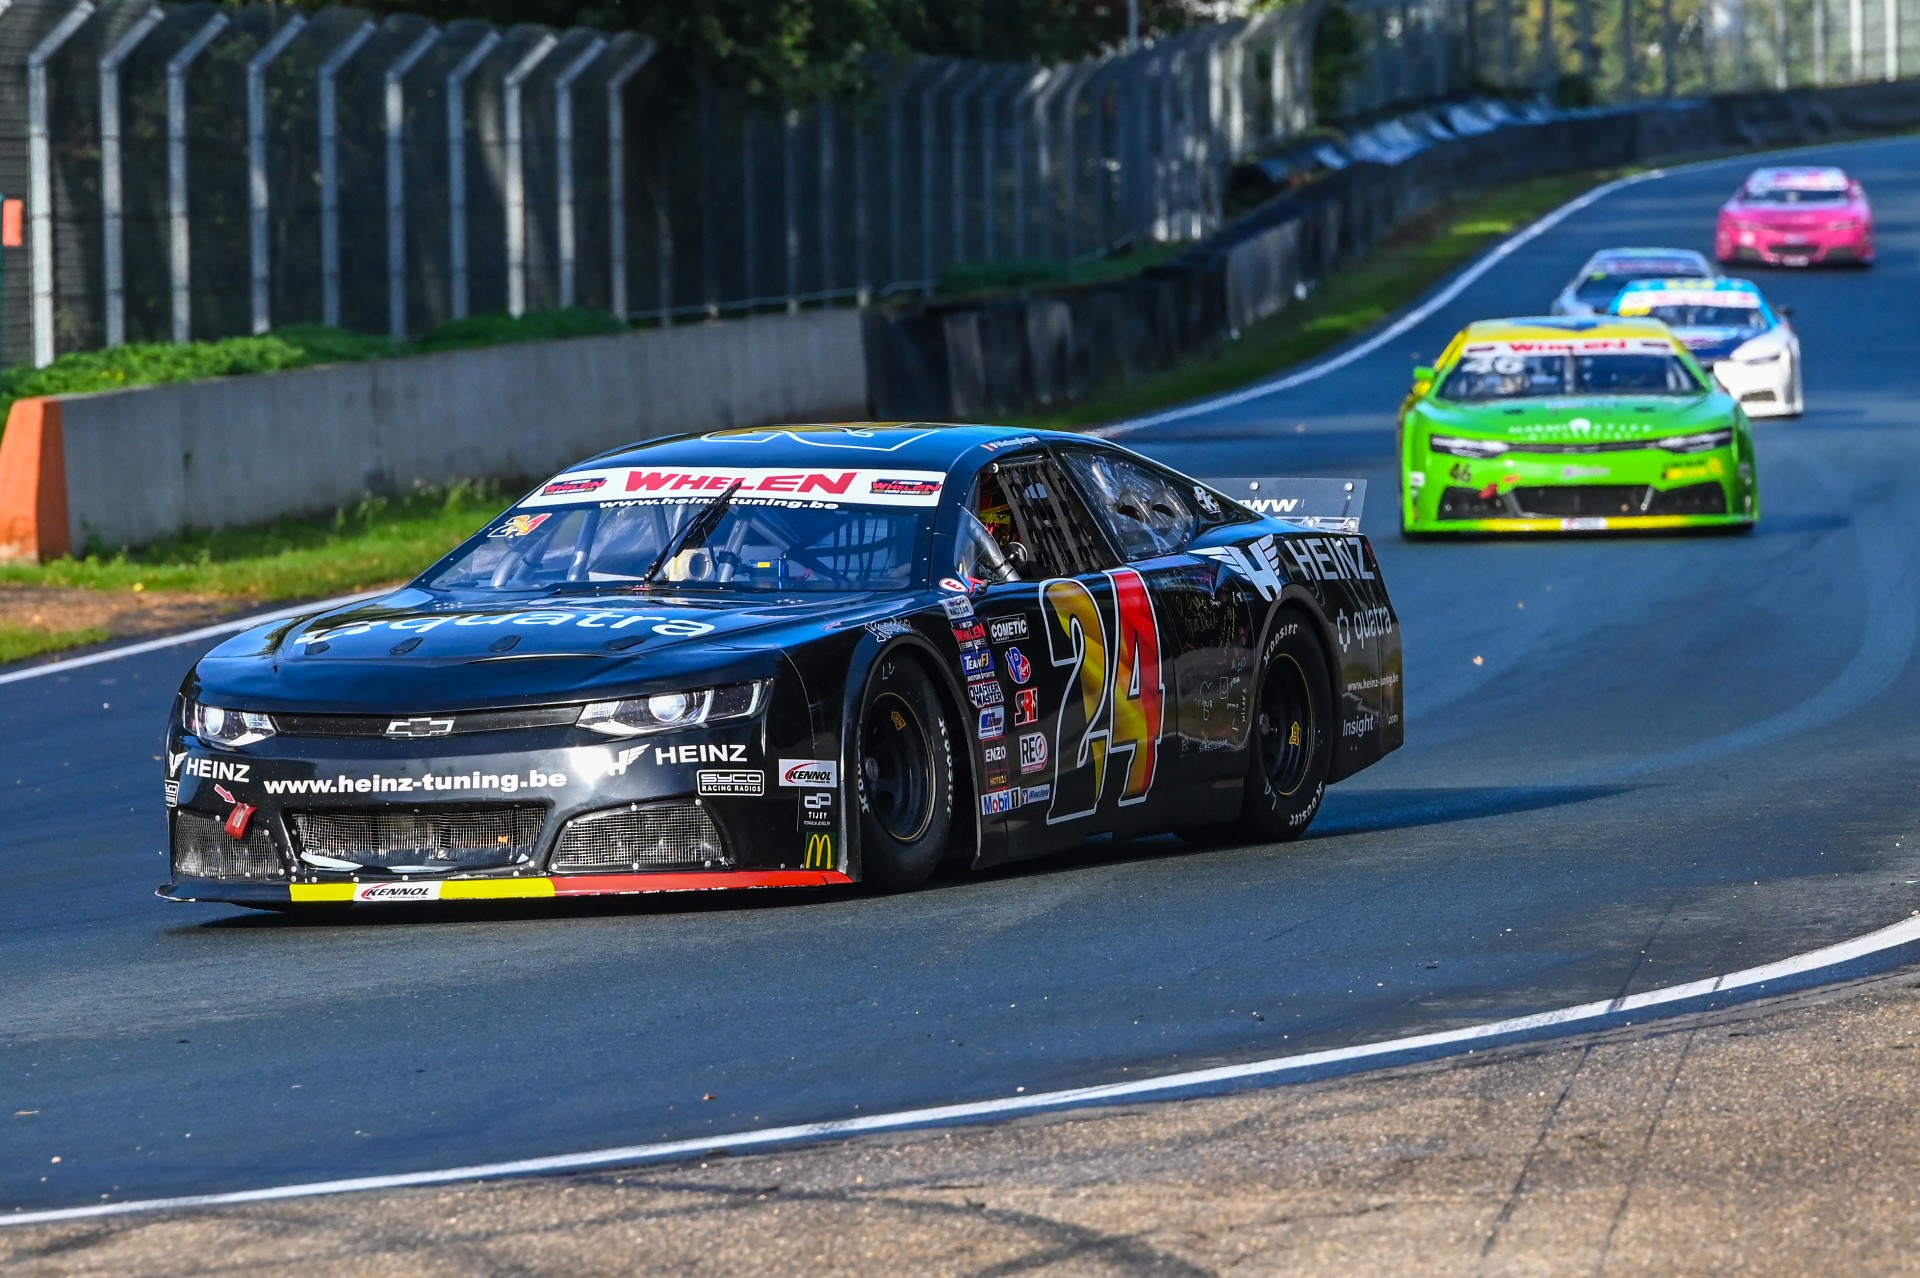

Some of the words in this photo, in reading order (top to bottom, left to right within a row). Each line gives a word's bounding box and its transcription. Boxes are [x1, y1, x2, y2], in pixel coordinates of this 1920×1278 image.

[625, 471, 858, 494] WHELEN
[872, 482, 942, 492] WHELEN
[1284, 537, 1375, 580] HEINZ
[388, 610, 716, 637] quatra
[991, 619, 1027, 638] COMETIC
[1353, 603, 1393, 649] quatra
[1038, 568, 1165, 825] 24
[1342, 713, 1374, 737] Insight
[655, 744, 748, 766] HEINZ
[985, 745, 1006, 762] ENZO
[186, 757, 250, 783] HEINZ
[263, 769, 567, 794] www.heinz-tuning.be
[701, 774, 762, 783] SYCO
[789, 770, 831, 781] KENNOL
[983, 791, 1009, 815] Mobil
[366, 888, 429, 897] KENNOL
